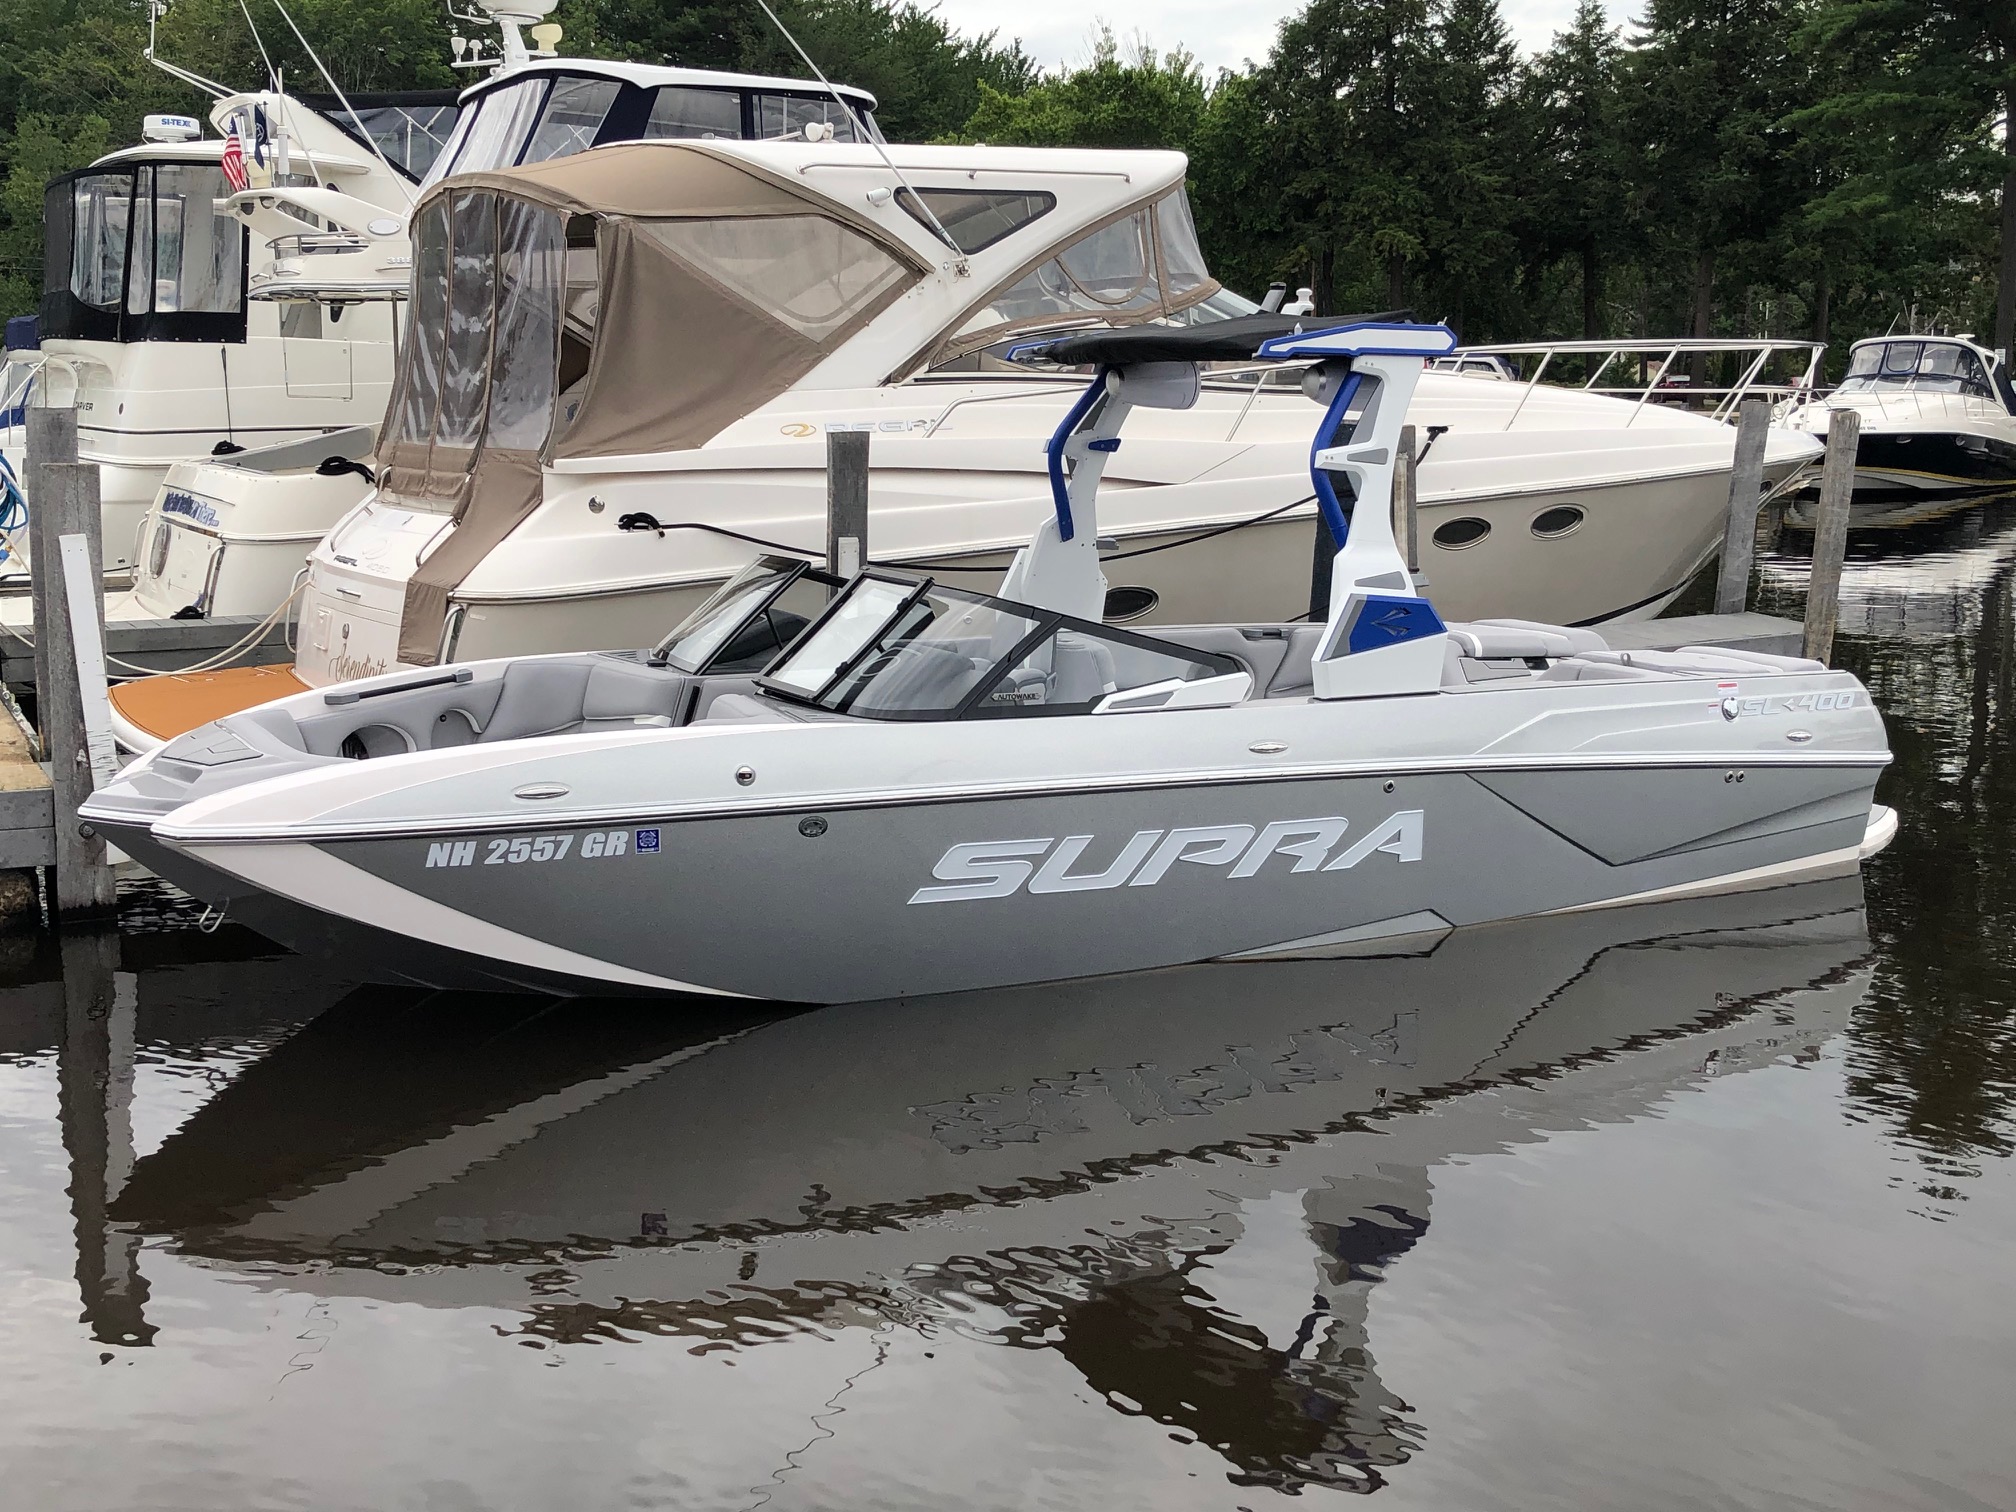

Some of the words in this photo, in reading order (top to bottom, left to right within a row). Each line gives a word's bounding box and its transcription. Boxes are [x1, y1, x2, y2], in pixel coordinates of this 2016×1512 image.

[1798, 691, 1855, 712] 400
[425, 841, 477, 868] NH
[484, 834, 574, 864] 2557
[580, 830, 630, 859] GR
[907, 809, 1424, 905] SUPRA
